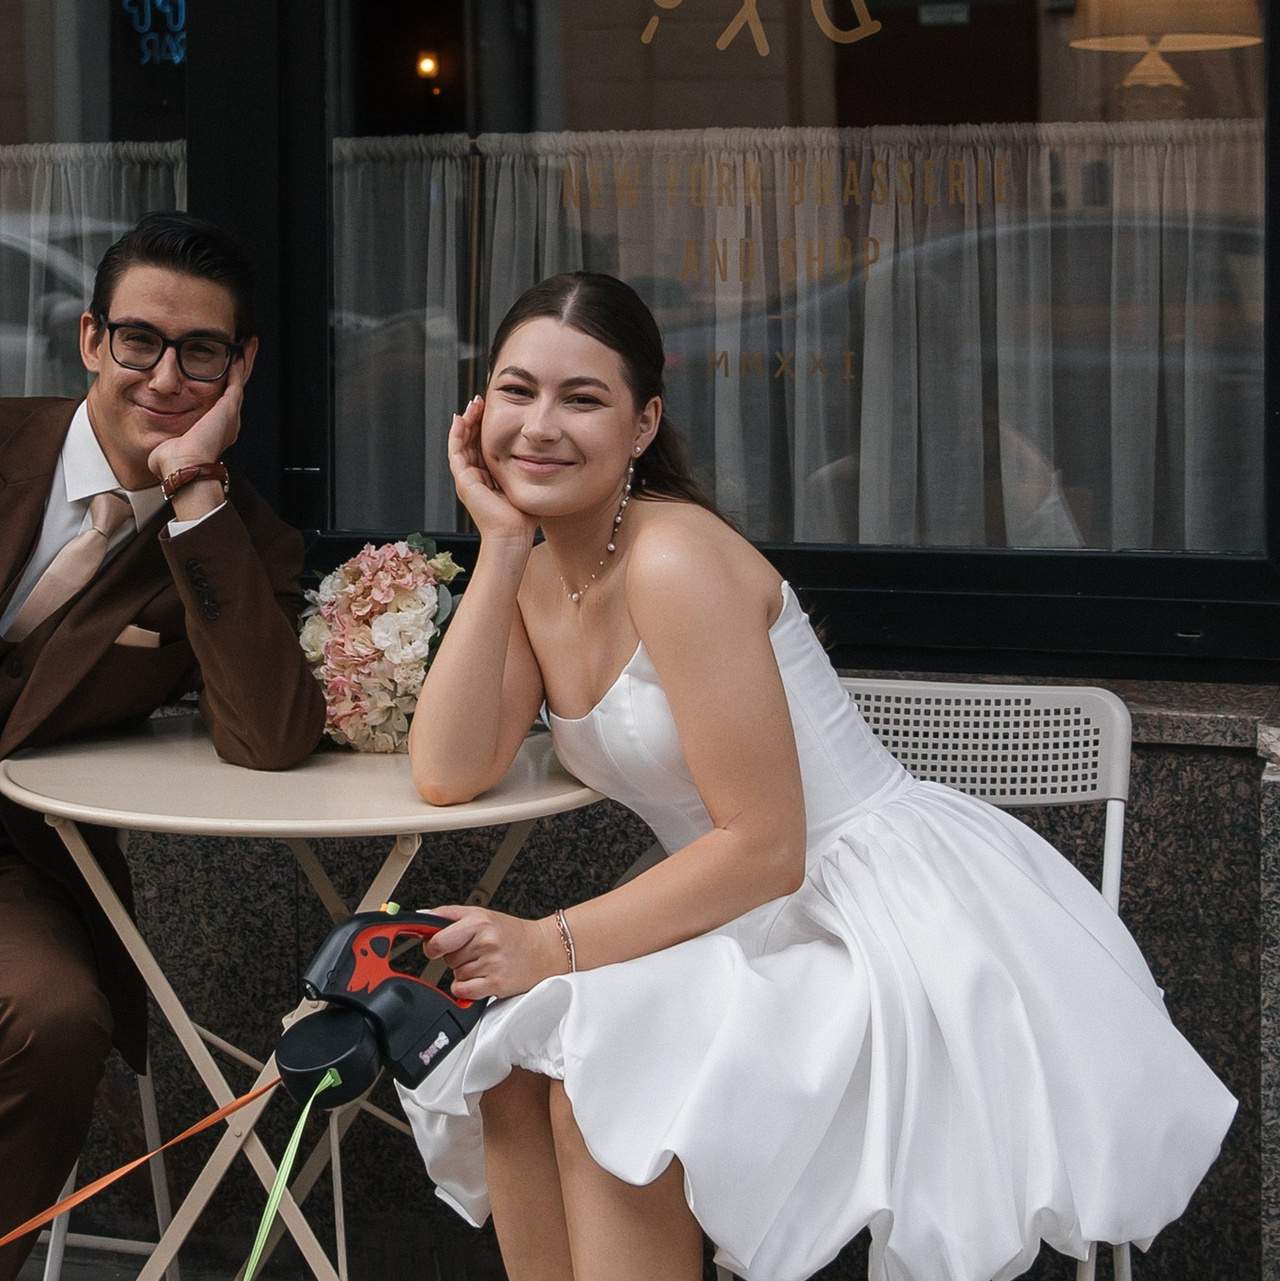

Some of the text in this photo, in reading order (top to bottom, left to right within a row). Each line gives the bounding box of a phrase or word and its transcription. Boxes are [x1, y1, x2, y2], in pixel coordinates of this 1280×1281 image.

[561, 157, 1012, 208] NEW YORK BRASSERIE
[680, 234, 881, 283] AND SHOP
[706, 349, 857, 381] MMXXI
